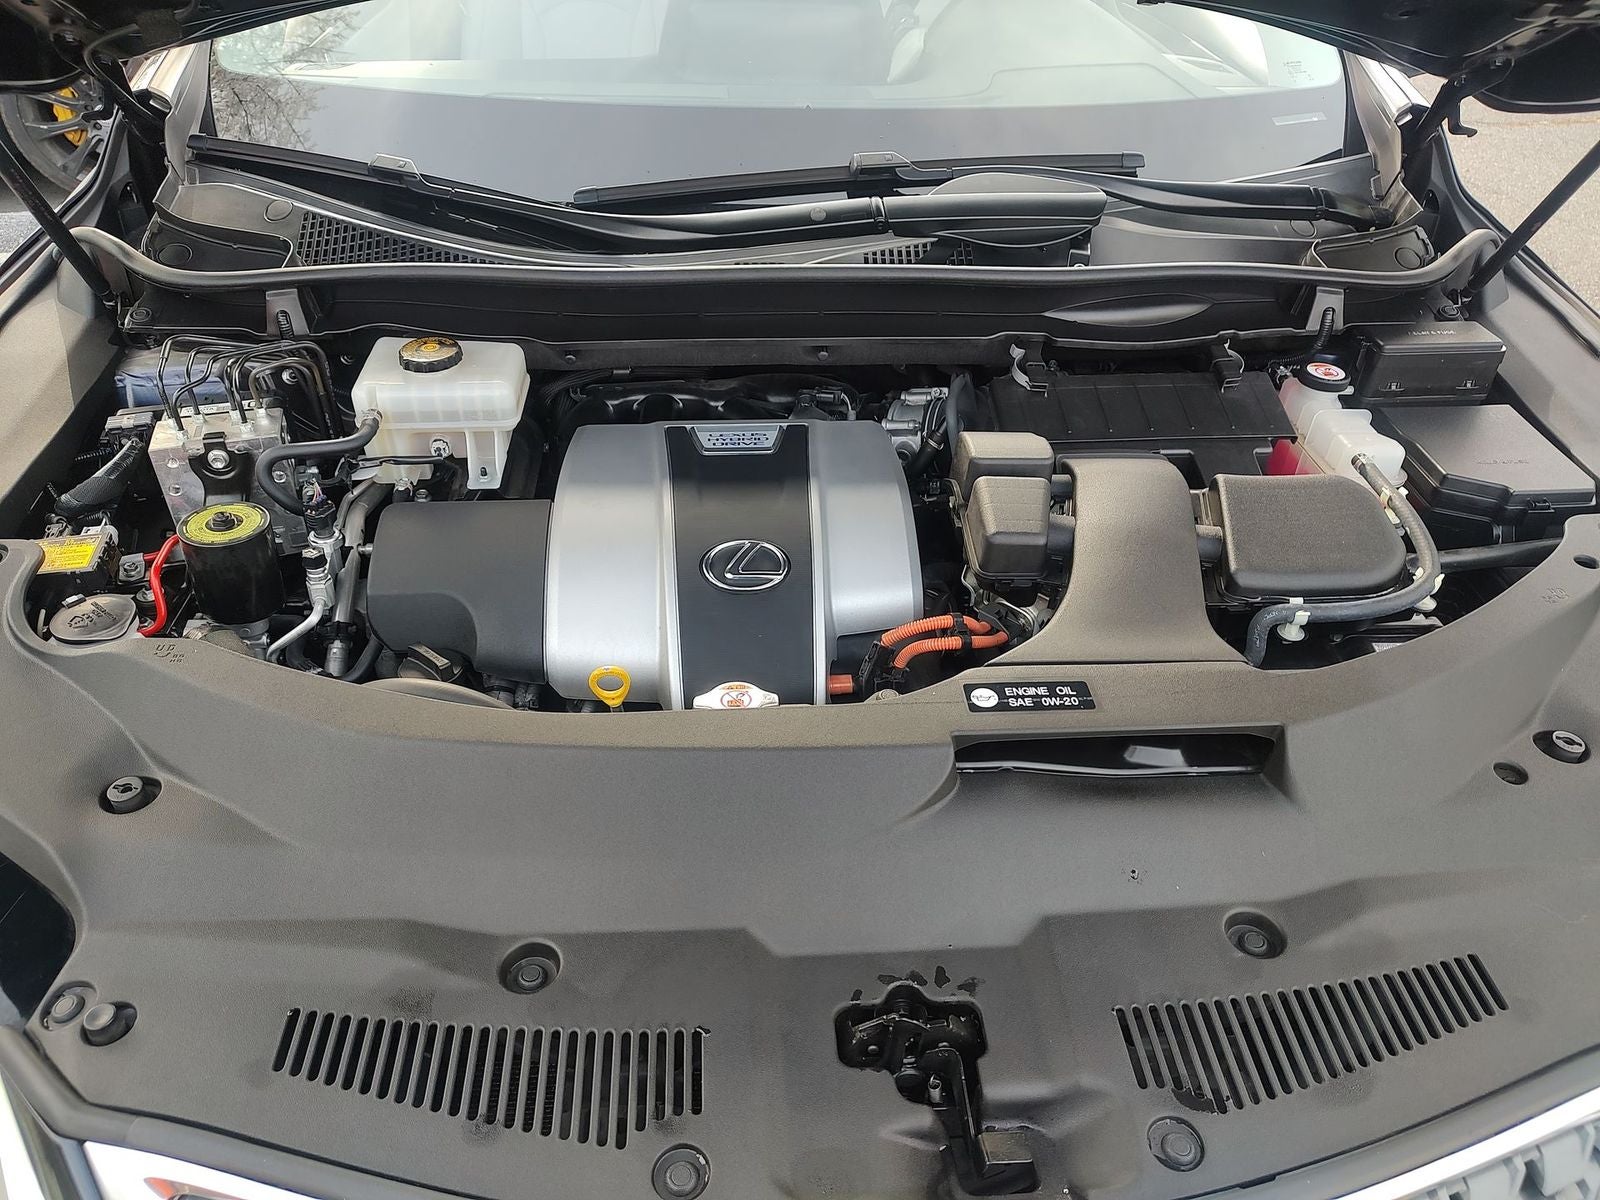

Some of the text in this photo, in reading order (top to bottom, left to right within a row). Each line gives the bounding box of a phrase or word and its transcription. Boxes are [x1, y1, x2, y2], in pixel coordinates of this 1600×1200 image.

[1004, 686, 1077, 696] ENGINE OIL
[1008, 696, 1079, 707] SAE 0W-20
